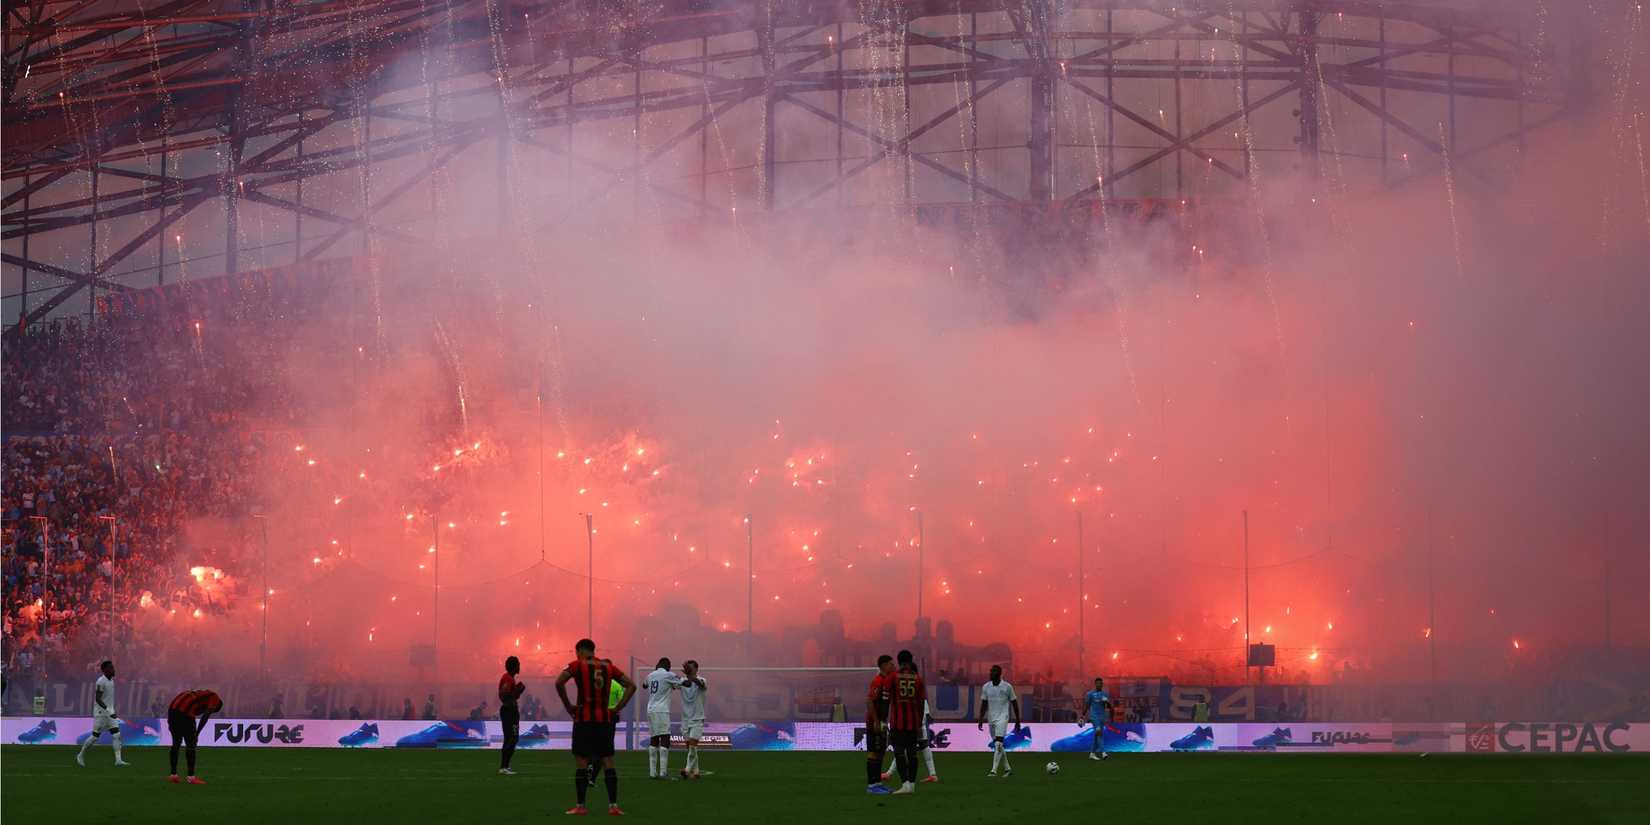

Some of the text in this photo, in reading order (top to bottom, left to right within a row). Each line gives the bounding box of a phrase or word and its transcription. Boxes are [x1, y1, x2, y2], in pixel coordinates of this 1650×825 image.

[593, 670, 605, 689] 5
[650, 681, 659, 694] 19
[899, 680, 916, 697] 55
[1169, 687, 1256, 721] 84
[213, 723, 305, 744] FUTURE
[1498, 722, 1631, 753] CEPAC
